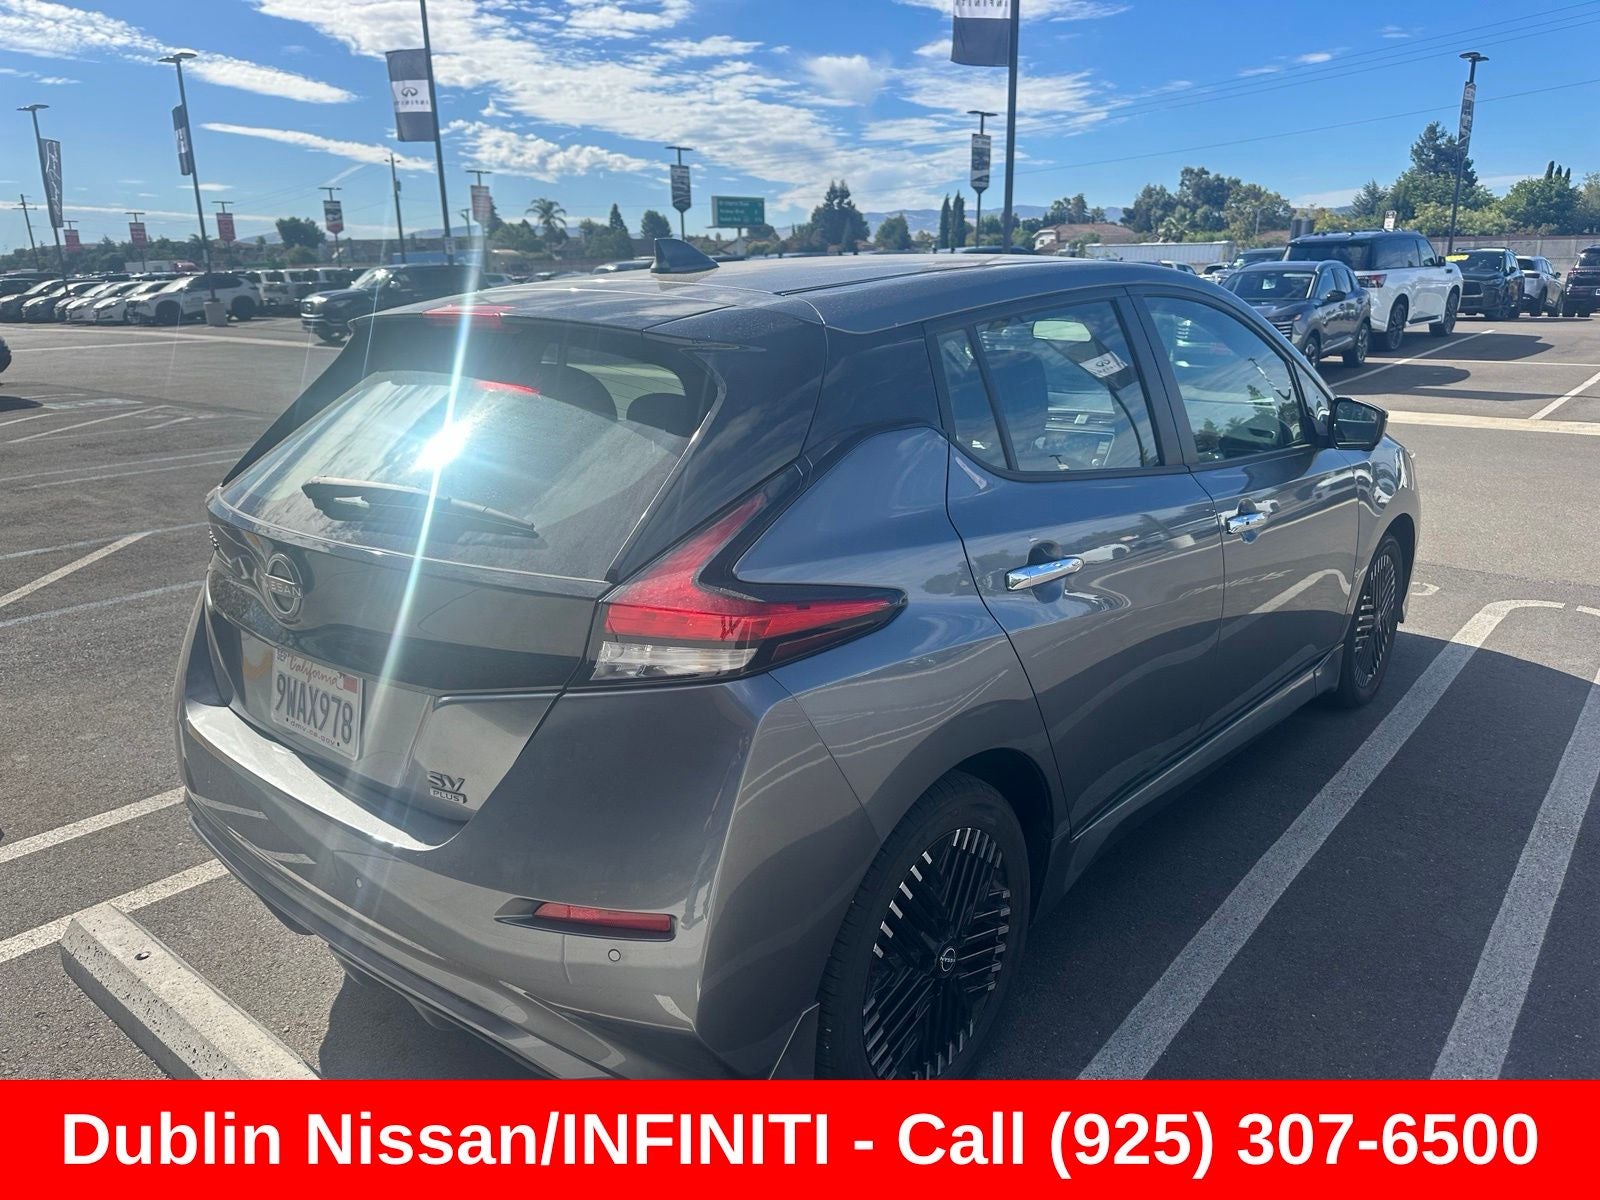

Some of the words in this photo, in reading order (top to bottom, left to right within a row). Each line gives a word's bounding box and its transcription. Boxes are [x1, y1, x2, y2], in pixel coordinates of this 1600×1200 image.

[287, 654, 338, 686] California
[275, 672, 353, 744] 9WAX978
[427, 770, 466, 792] SV
[432, 790, 461, 802] PLUS
